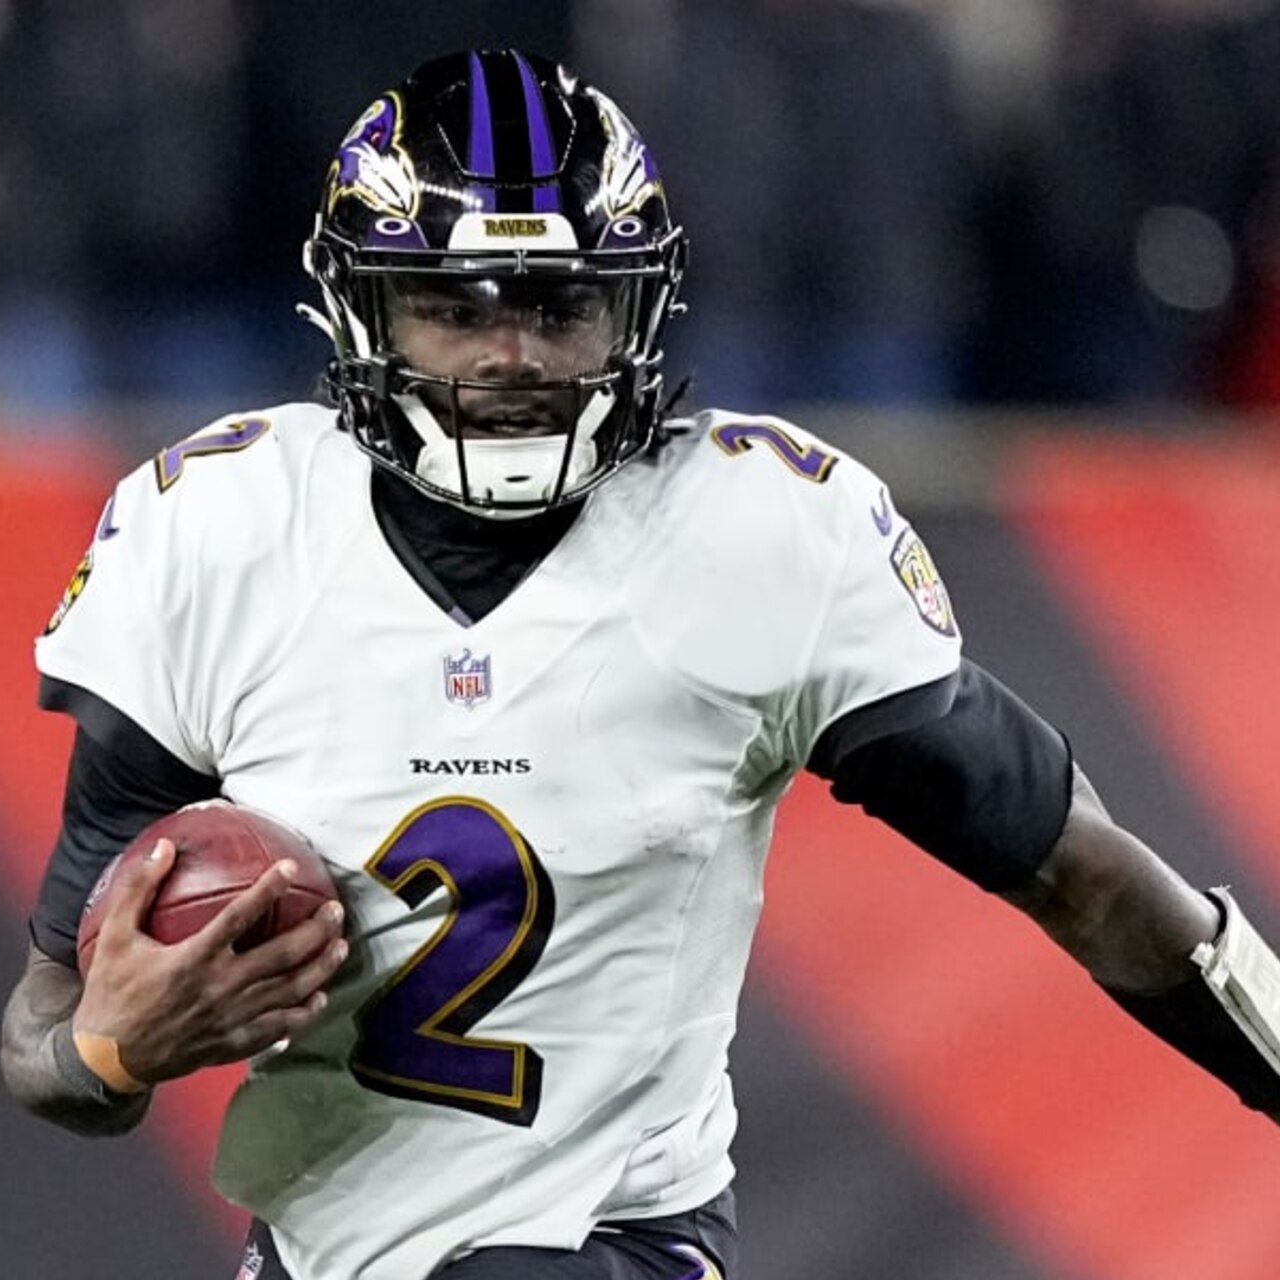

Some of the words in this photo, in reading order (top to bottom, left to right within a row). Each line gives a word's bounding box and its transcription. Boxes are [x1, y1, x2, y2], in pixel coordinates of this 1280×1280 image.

[483, 219, 547, 238] RAVENS
[711, 424, 838, 483] 2
[451, 674, 486, 699] NFL
[409, 758, 532, 775] RAVENS
[349, 795, 556, 1128] 2
